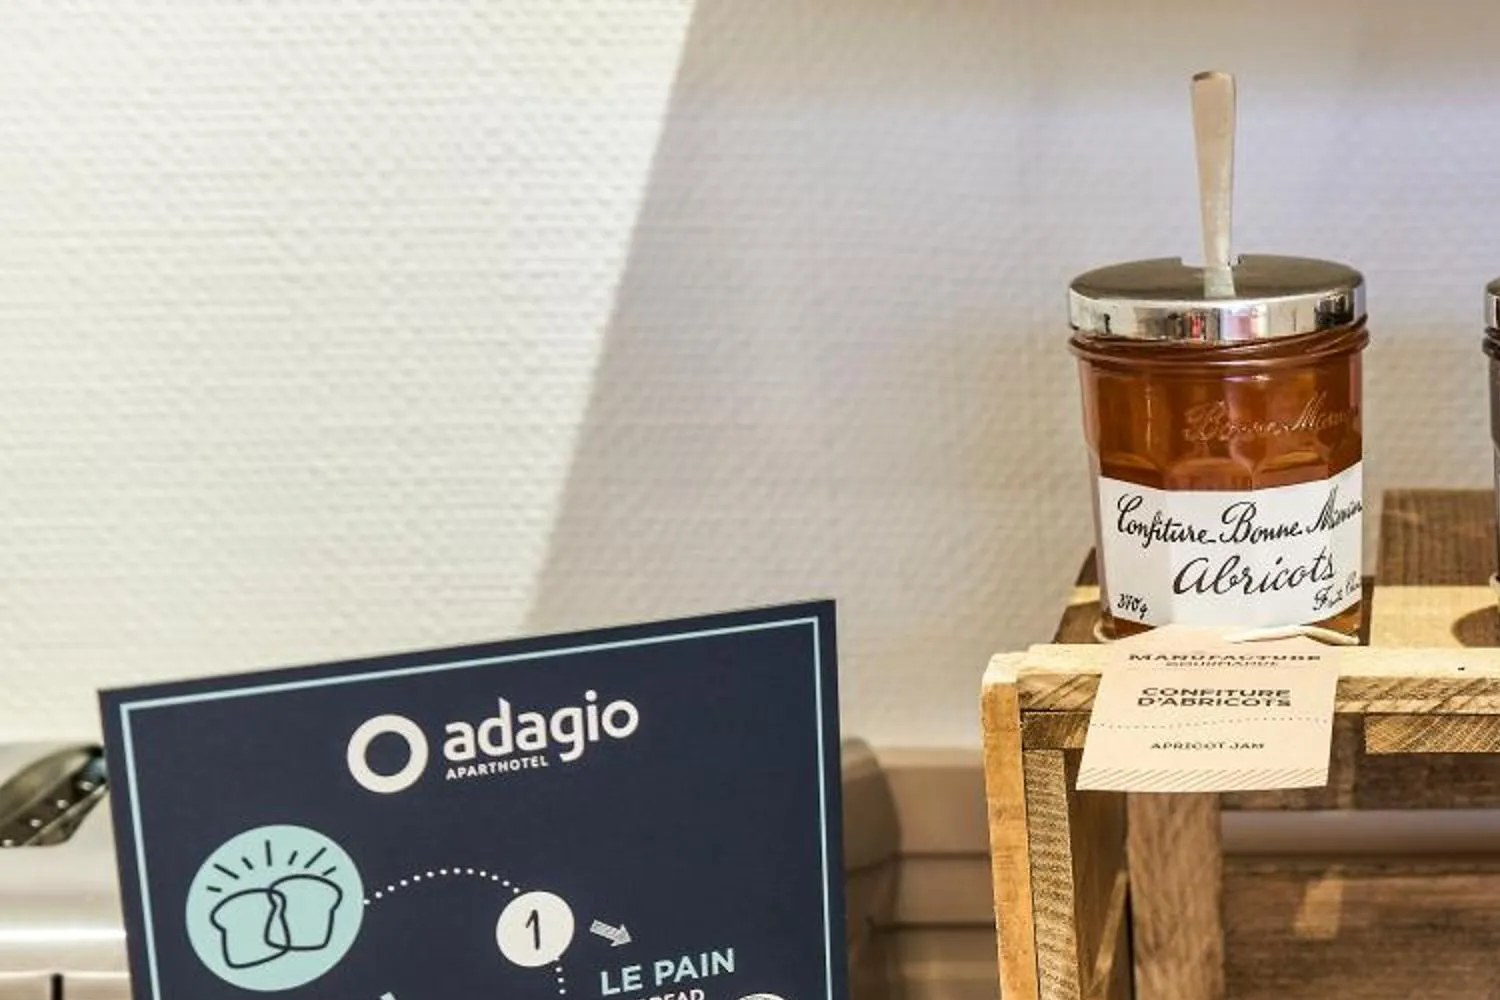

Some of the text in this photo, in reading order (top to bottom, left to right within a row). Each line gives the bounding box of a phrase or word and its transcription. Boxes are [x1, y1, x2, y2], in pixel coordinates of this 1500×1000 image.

[1117, 493, 1217, 549] Confiture
[1219, 501, 1303, 546] Bonne
[1173, 546, 1335, 596] Abricots
[1137, 697, 1292, 707] D'ABRICOTS
[1141, 687, 1291, 697] CONFITURE
[444, 690, 638, 762] adagio
[1151, 742, 1265, 750] APRICOT JAM
[445, 755, 548, 780] APARTHOTEL
[525, 910, 541, 950] 1
[600, 948, 735, 996] LE PAIN
